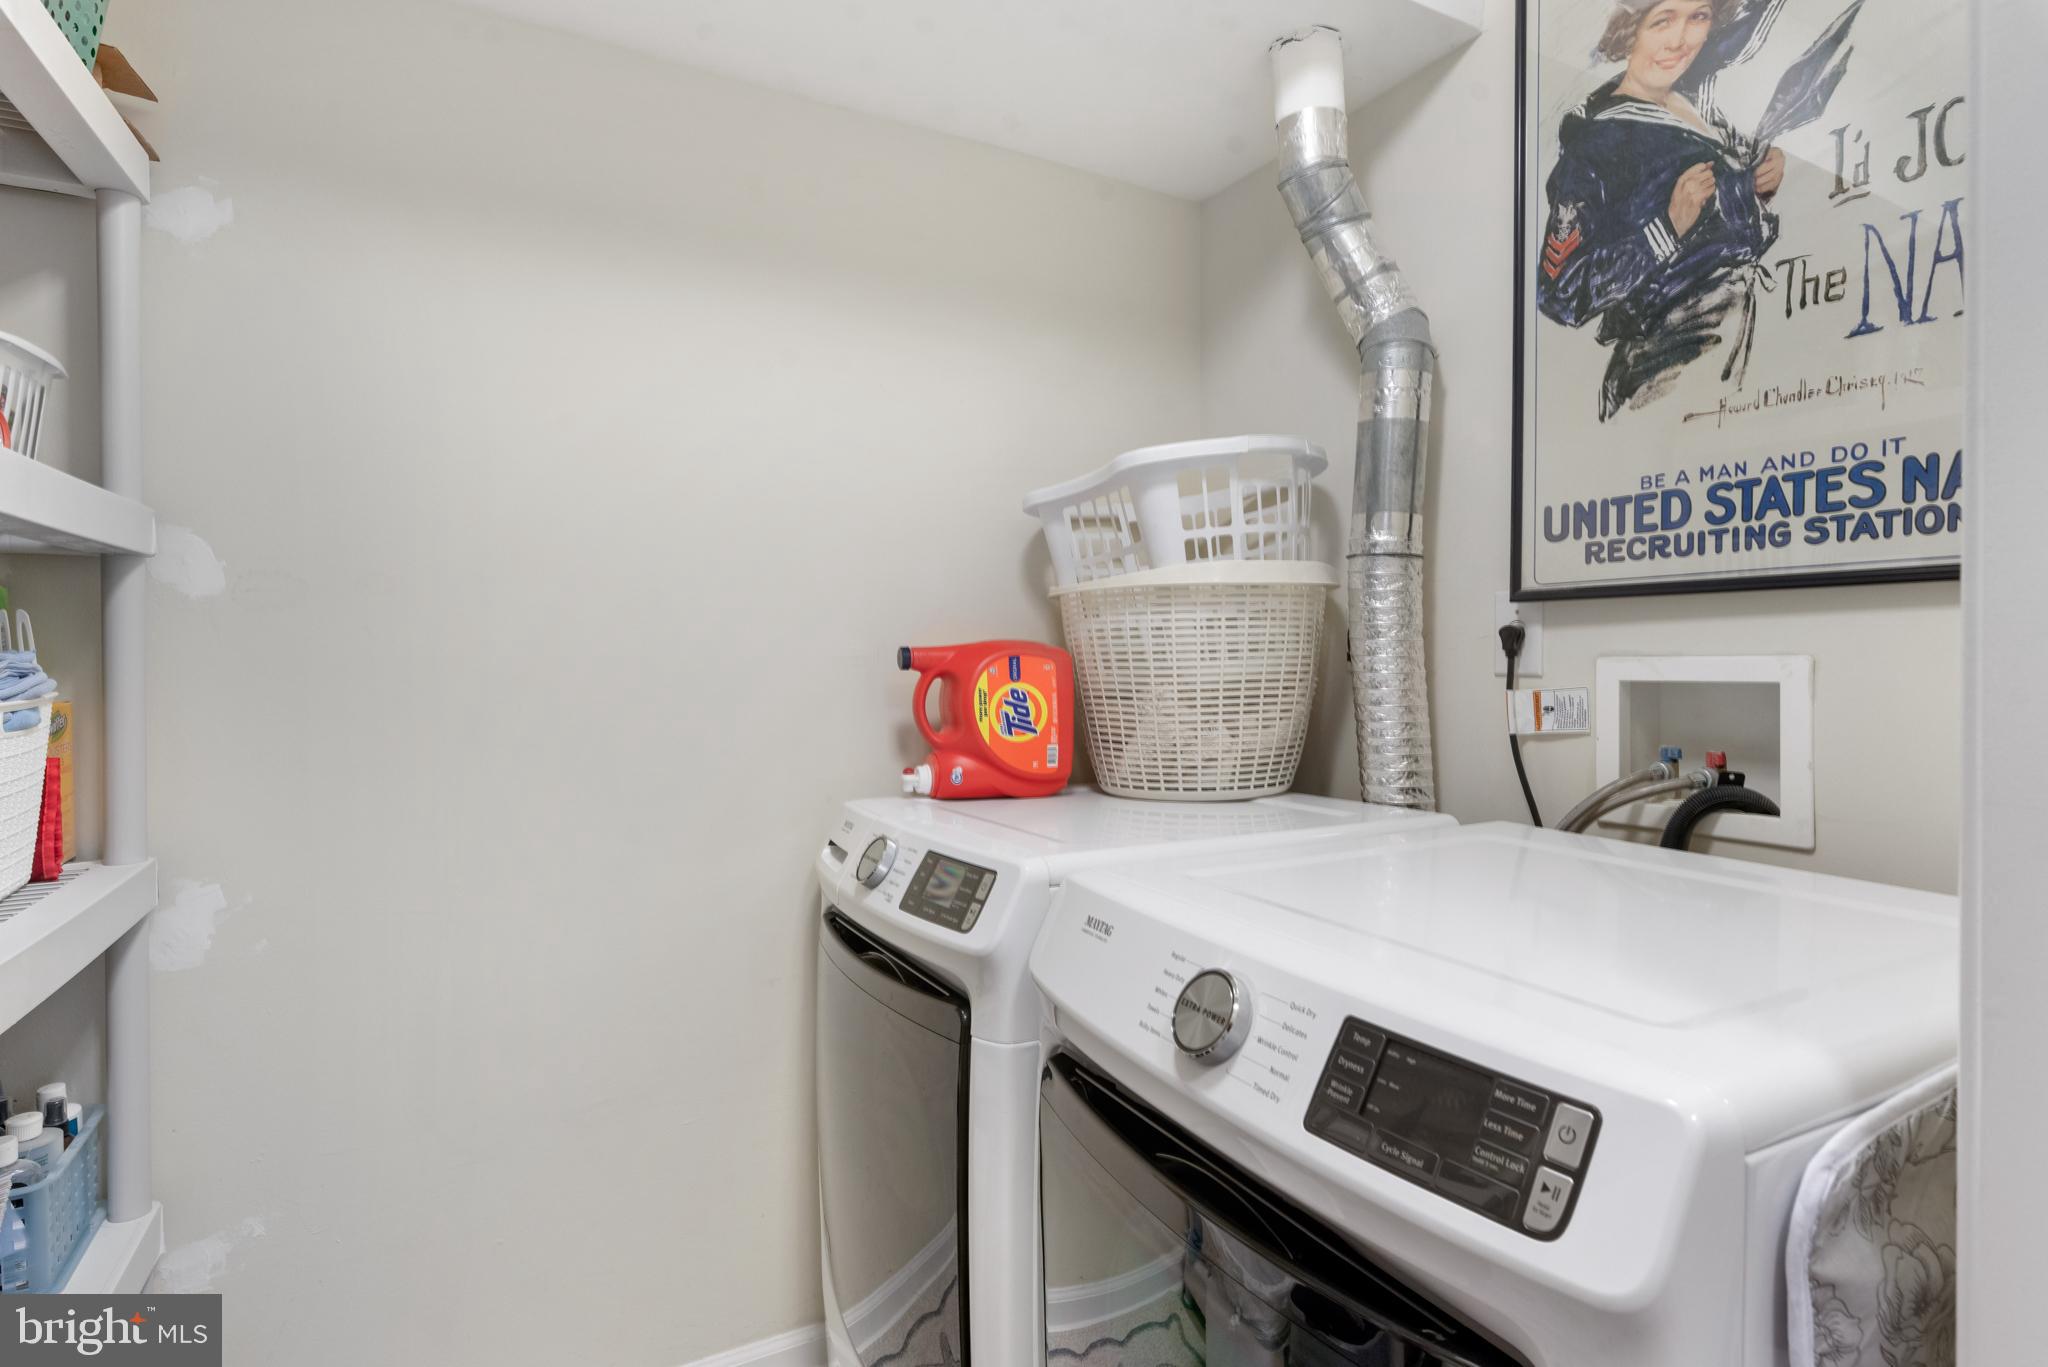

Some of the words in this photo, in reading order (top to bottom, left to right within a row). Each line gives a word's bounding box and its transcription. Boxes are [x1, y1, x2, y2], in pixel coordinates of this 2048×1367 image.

[1829, 124, 1871, 200] I'd
[1775, 254, 1848, 319] The
[1844, 197, 1965, 339] NA
[1763, 378, 1823, 409] Chandler
[1640, 472, 1666, 491] BE
[1674, 469, 1691, 486] A
[1699, 459, 1748, 482] MAN
[1763, 450, 1816, 472] AND
[1831, 441, 1869, 462] DO
[1881, 436, 1907, 457] IT
[1543, 488, 1693, 544] UNITED
[1703, 460, 1887, 526] STATES
[1584, 520, 1792, 565] RECRUITING
[1004, 688, 1038, 737] Tide
[1181, 997, 1201, 1013] EXTRA
[1202, 1007, 1226, 1026] POWER
[1290, 1001, 1306, 1015] Quick
[1305, 1007, 1317, 1020] Dry
[1281, 1022, 1308, 1040] Delicates
[1353, 1031, 1371, 1048] Temp
[1270, 1065, 1291, 1083] Normal
[1338, 1055, 1365, 1075] Dryness
[1268, 1091, 1281, 1104] Dry
[1494, 1089, 1515, 1105] More
[1516, 1096, 1537, 1113] Time
[1483, 1117, 1502, 1133] Less
[1503, 1125, 1524, 1142] Time
[1380, 1141, 1400, 1159] Cycle
[1400, 1150, 1425, 1169] Signal
[1474, 1146, 1505, 1164] Control
[1505, 1158, 1525, 1175] Lock
